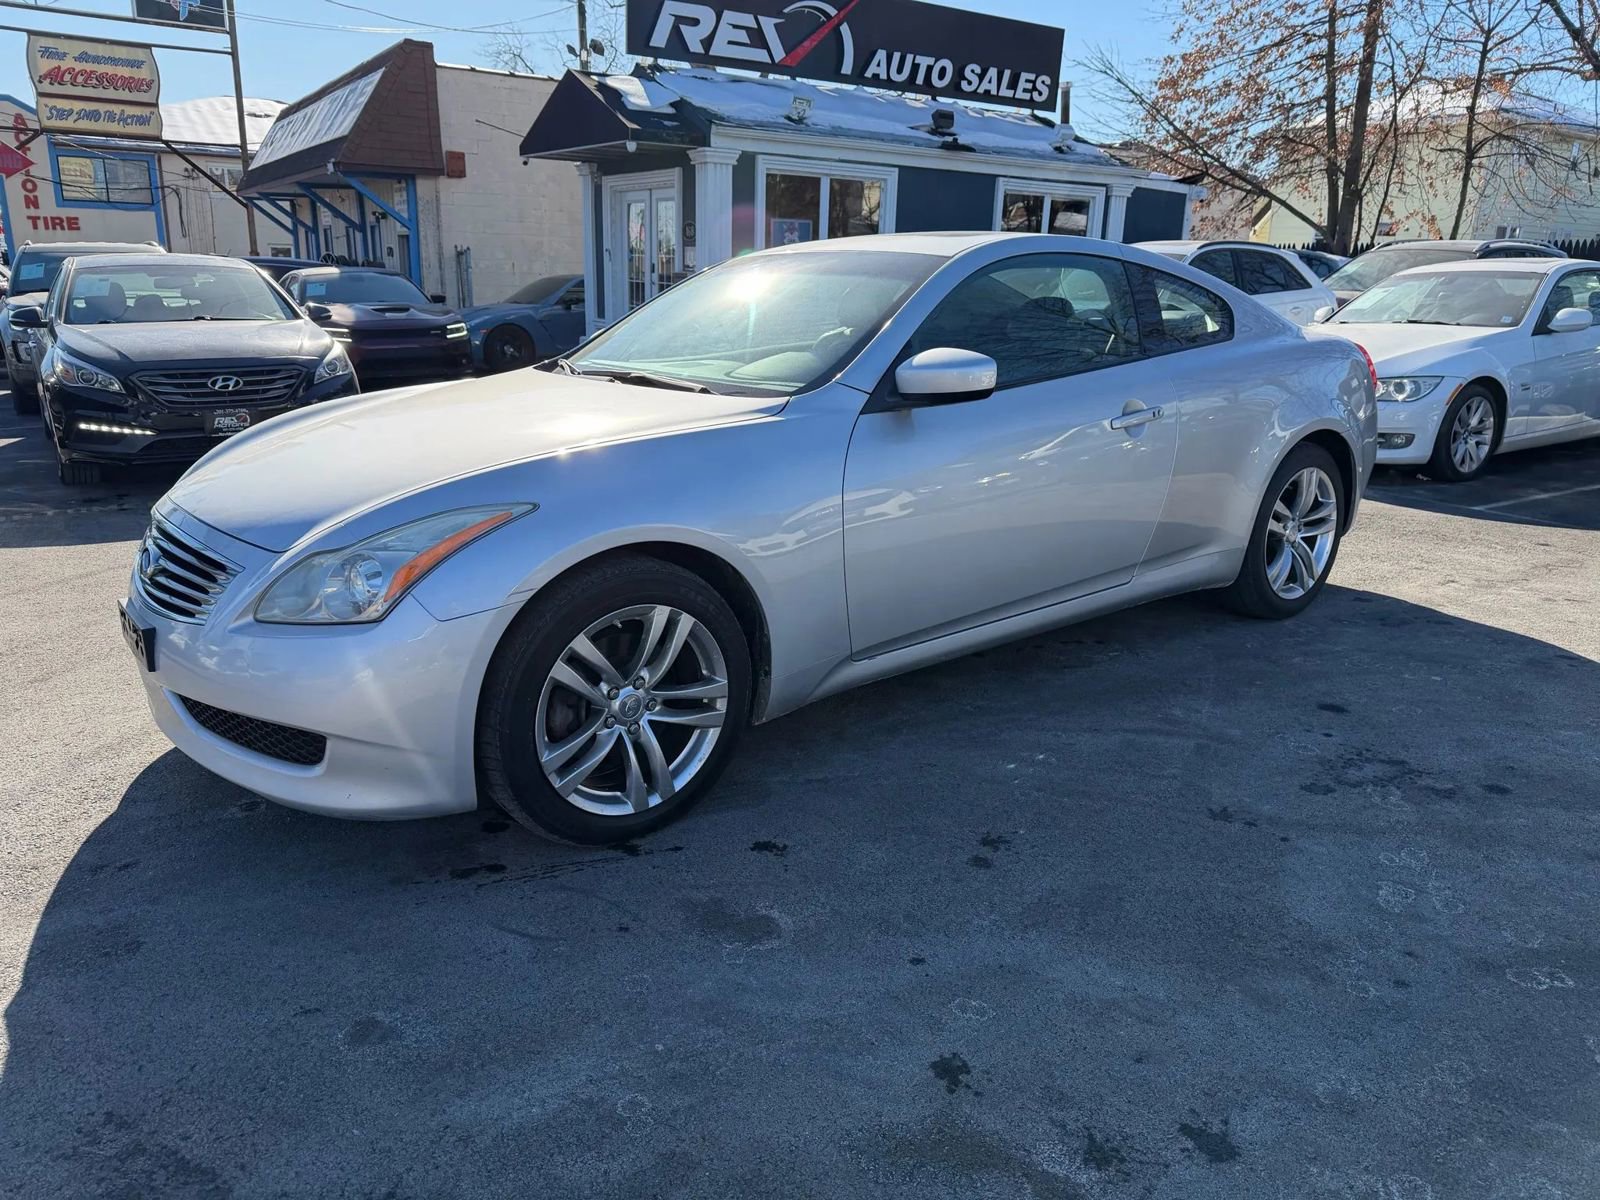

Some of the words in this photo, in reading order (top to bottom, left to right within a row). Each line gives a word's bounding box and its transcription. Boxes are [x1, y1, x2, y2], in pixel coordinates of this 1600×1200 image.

[38, 64, 155, 93] ACCESSORIES
[864, 48, 954, 89] AUTO
[960, 63, 1051, 103] SALES
[73, 107, 102, 123] INTO
[26, 215, 81, 231] TIRE
